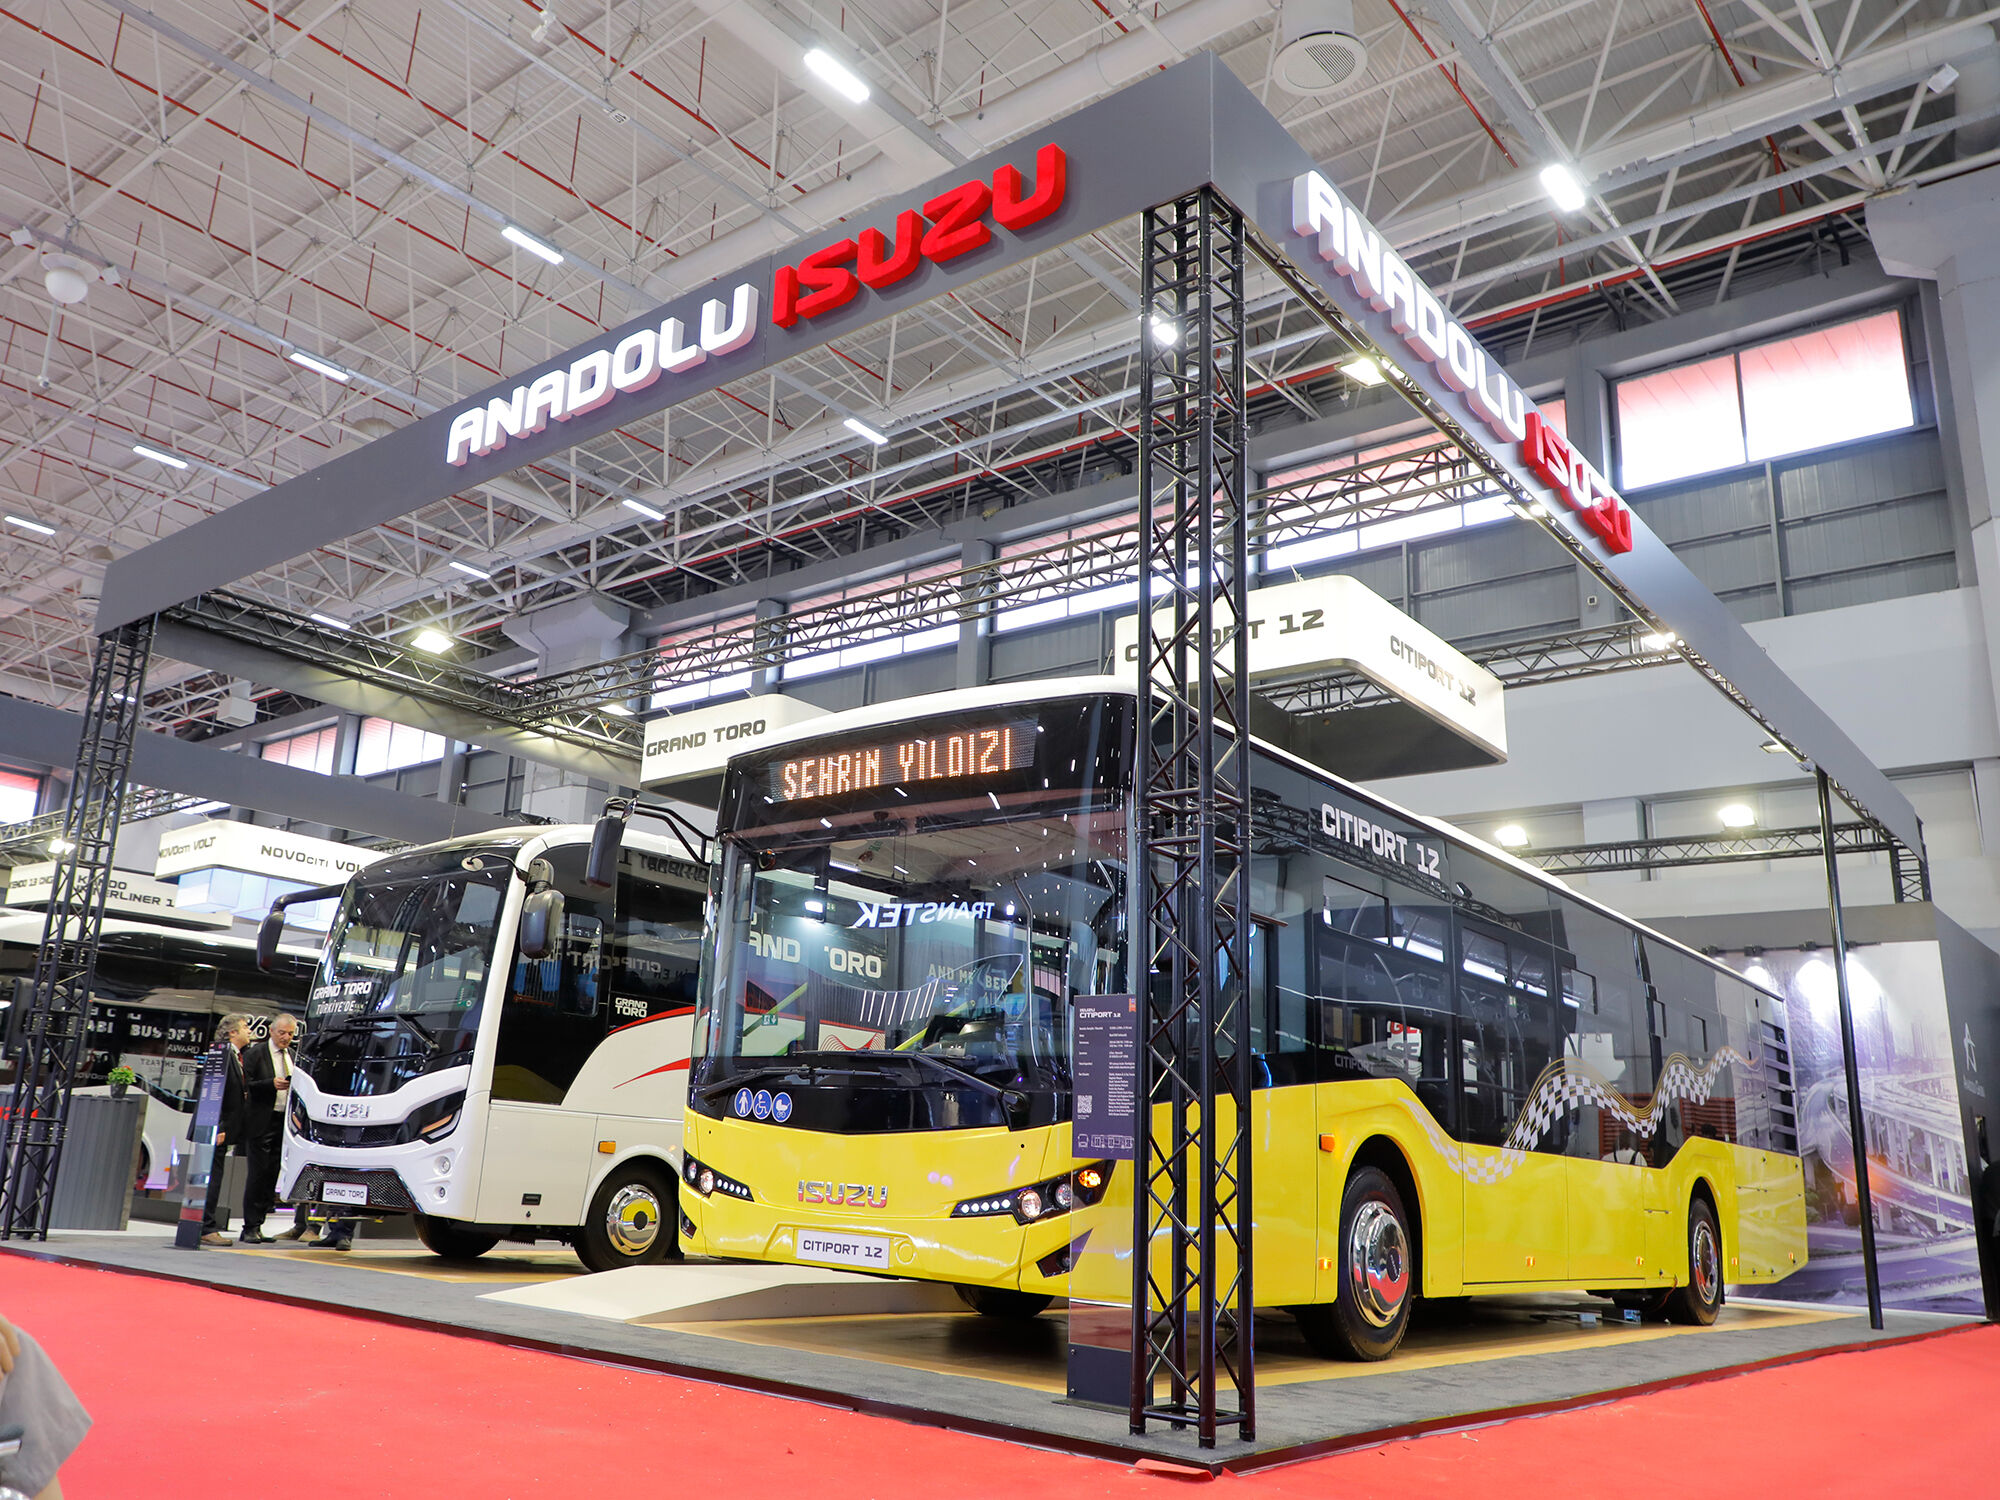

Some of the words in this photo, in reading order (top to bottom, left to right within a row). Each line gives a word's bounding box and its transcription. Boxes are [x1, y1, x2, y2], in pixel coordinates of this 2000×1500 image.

[446, 283, 759, 467] ANADOLU
[772, 142, 1066, 330] ISUZU
[1292, 169, 1526, 443] ANADOLU
[1523, 411, 1633, 554] ISUZU
[1125, 619, 1265, 662] CTPORT
[1279, 609, 1325, 635] 12
[1390, 634, 1455, 691] CITIPORT
[1458, 679, 1476, 707] 12
[646, 731, 707, 757] GRAND
[713, 719, 766, 743] TORO
[193, 836, 216, 850] VOLT
[1321, 803, 1408, 865] CITIPORT
[1416, 843, 1441, 880] 12
[335, 860, 360, 872] VO
[78, 875, 127, 890] KDO
[928, 963, 955, 981] AND
[959, 970, 1008, 992] MEBER
[313, 984, 341, 1000] GRAND
[343, 981, 372, 995] TORO
[615, 997, 648, 1009] GRAND
[615, 1004, 648, 1018] TORO
[326, 1103, 370, 1119] ISUZU
[325, 1187, 346, 1197] GRAND
[348, 1190, 365, 1199] TORO
[797, 1180, 888, 1209] ISUZU
[803, 1240, 859, 1256] CITIPORT
[865, 1246, 883, 1258] 12
